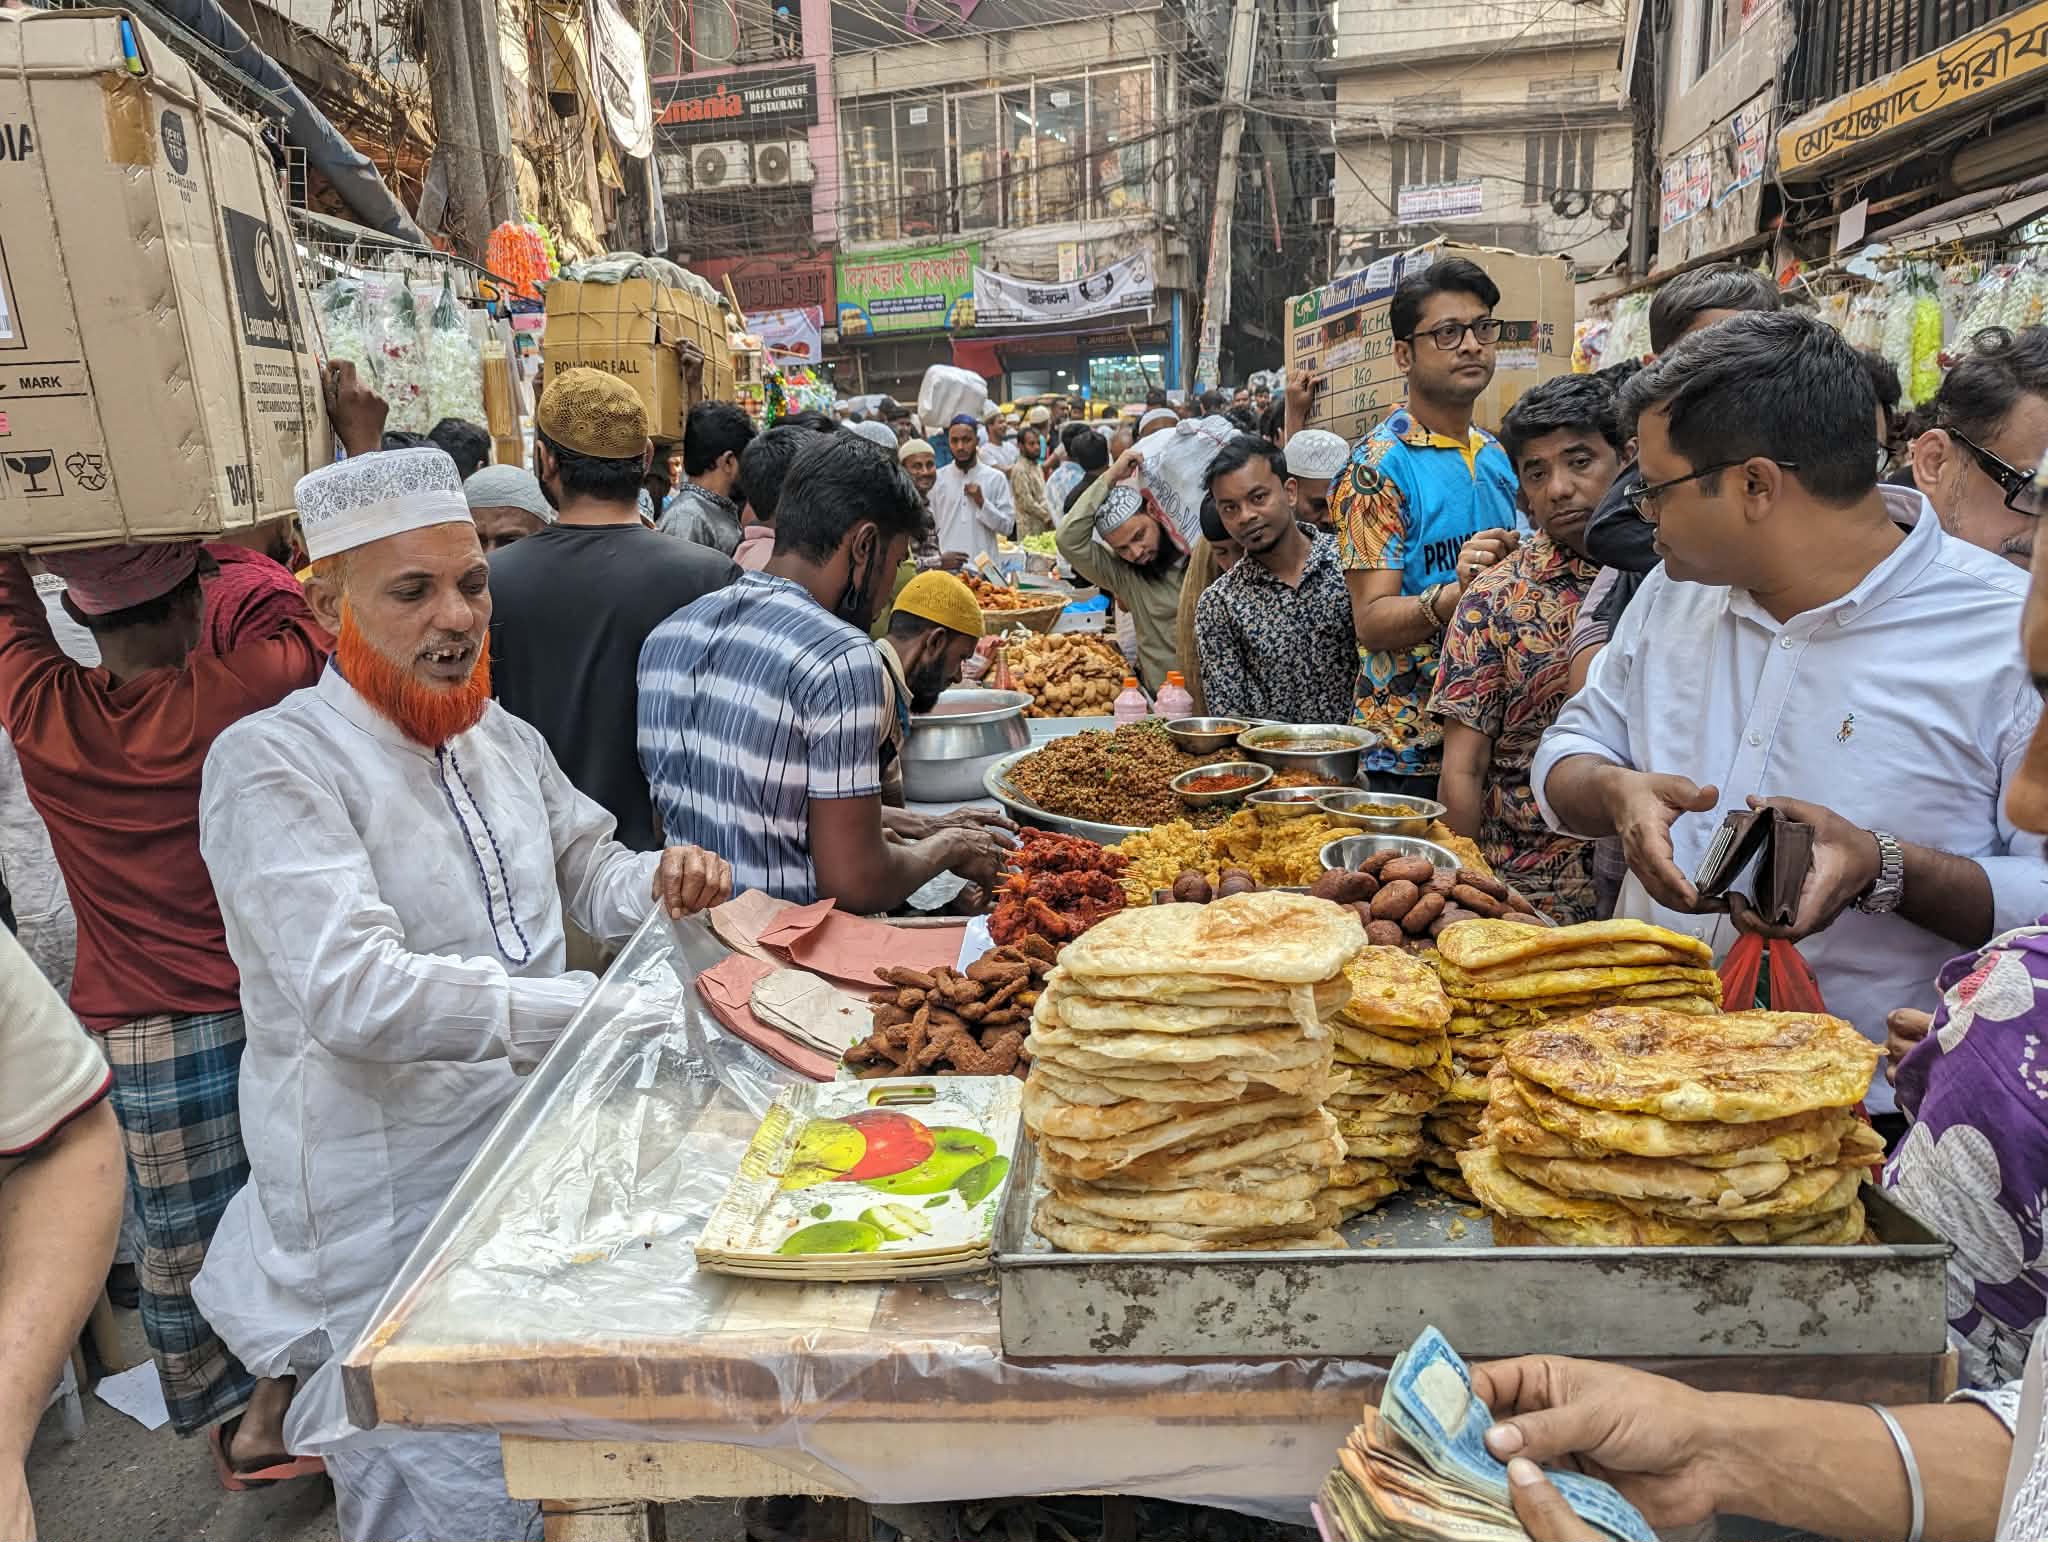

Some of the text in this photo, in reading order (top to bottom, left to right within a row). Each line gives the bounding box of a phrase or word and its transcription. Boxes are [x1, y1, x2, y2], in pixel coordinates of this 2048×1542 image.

[744, 89, 766, 101] THAI
[773, 84, 809, 98] CHINESE
[750, 98, 804, 114] RESTAURANT
[167, 171, 199, 193] STANDARD
[1296, 333, 1315, 352] COUNT
[19, 376, 63, 396] MARK
